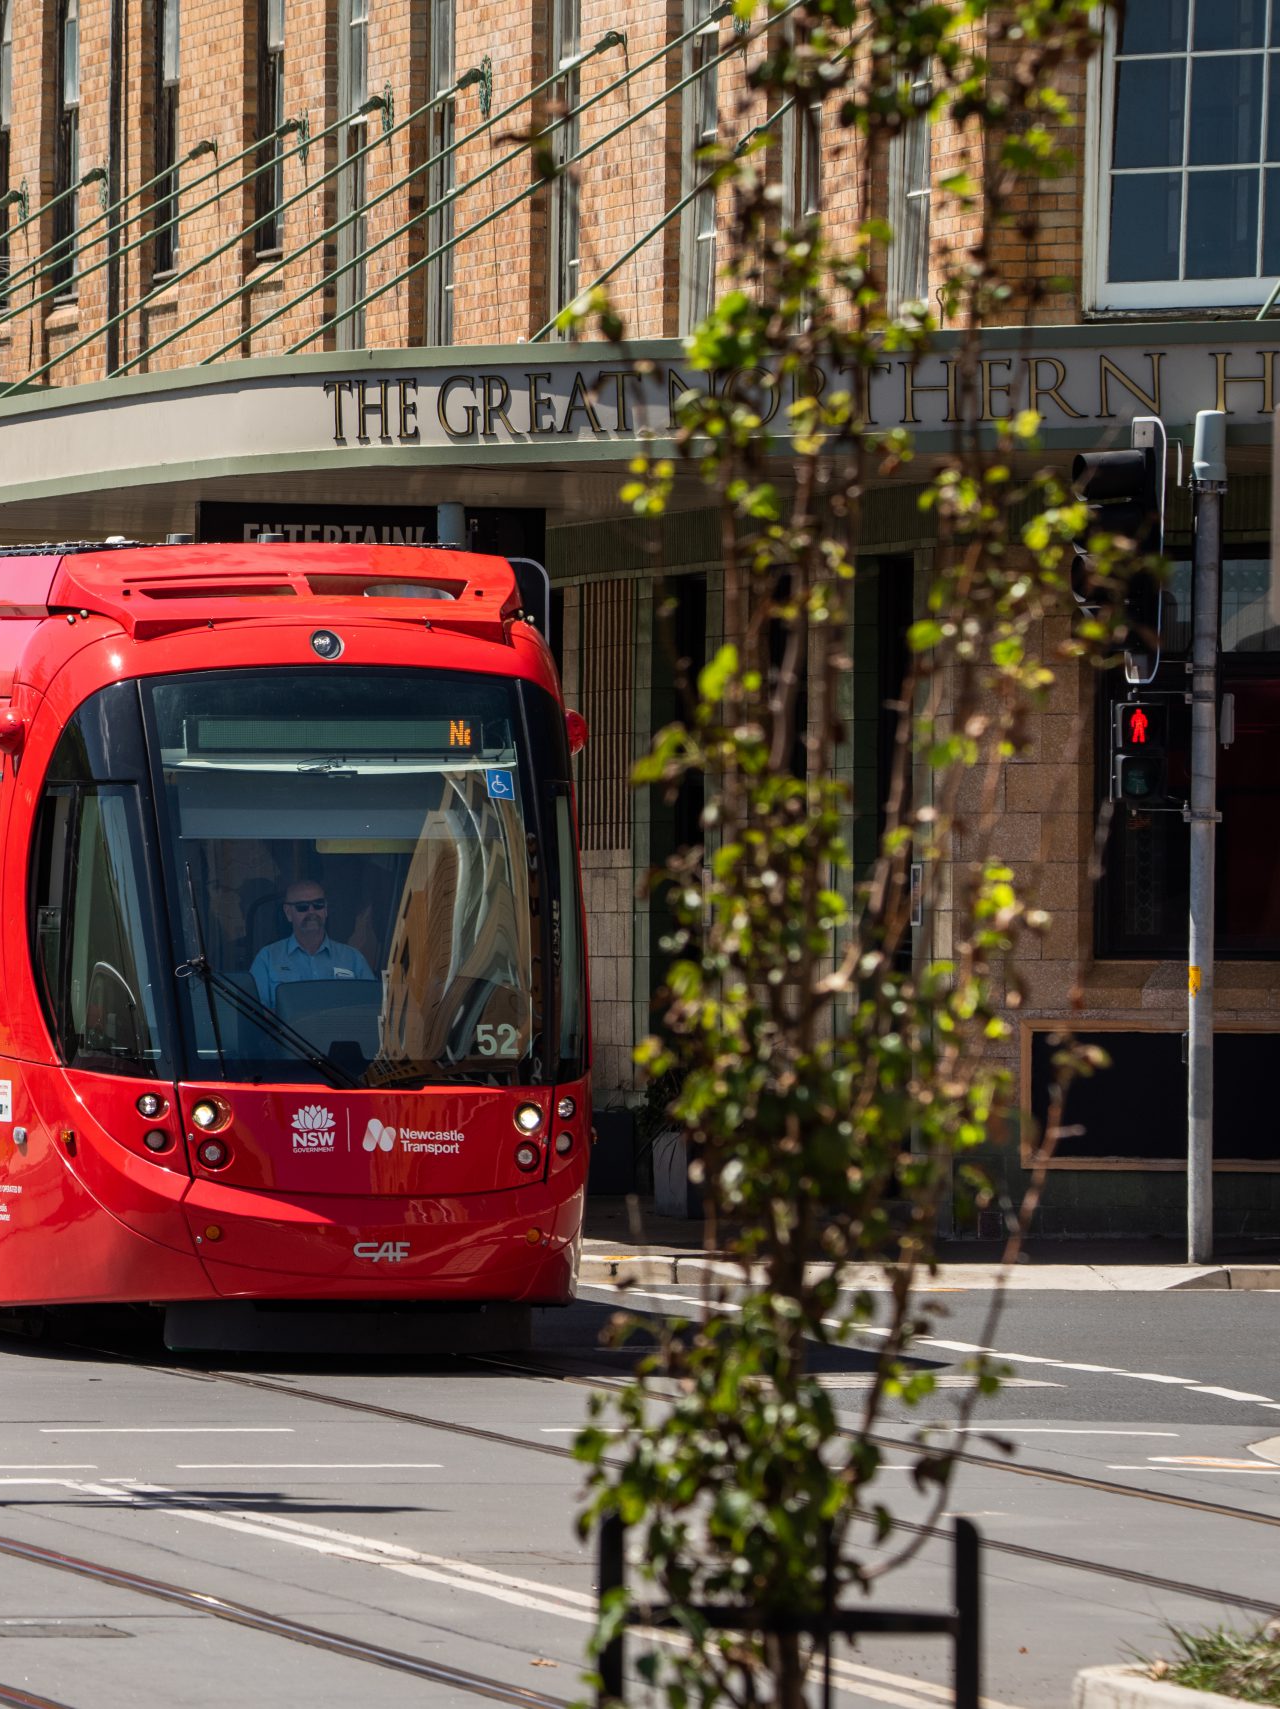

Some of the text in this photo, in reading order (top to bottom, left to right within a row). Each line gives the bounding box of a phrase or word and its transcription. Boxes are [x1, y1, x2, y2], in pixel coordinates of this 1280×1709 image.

[323, 377, 420, 440] THE
[437, 369, 643, 438] GREAT
[476, 1023, 520, 1056] 52
[292, 1131, 335, 1148] NSW
[399, 1127, 465, 1142] Newcastle
[292, 1146, 335, 1154] GOVERNMENT
[400, 1140, 460, 1156] Transport
[353, 1241, 411, 1263] CAF
